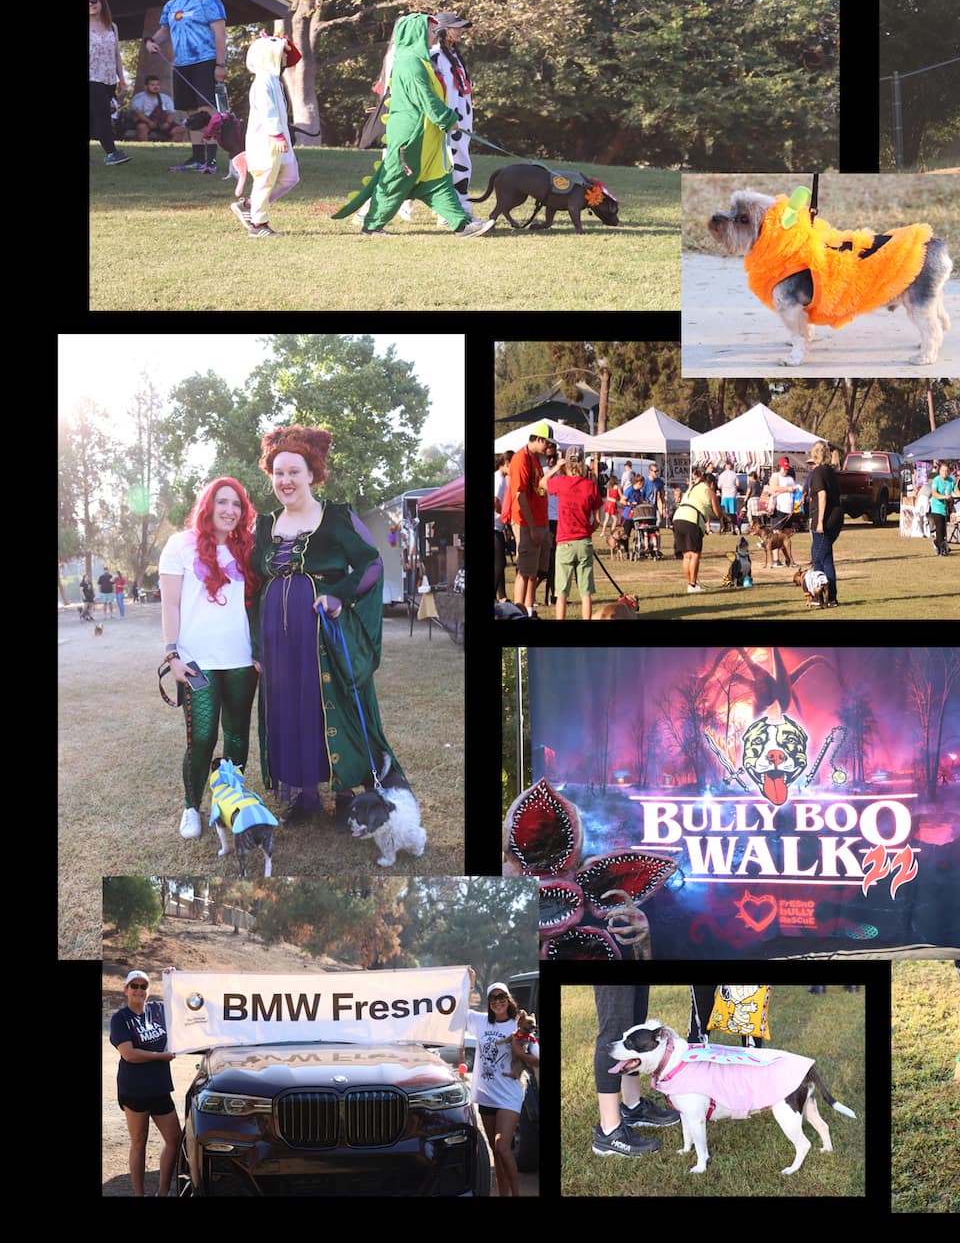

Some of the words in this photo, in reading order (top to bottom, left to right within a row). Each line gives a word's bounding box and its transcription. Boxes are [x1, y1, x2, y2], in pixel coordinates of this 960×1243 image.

[640, 801, 780, 844] BULLY
[794, 799, 912, 847] BOO
[682, 835, 867, 878] WALK
[861, 843, 919, 900] 22
[223, 993, 321, 1022] BMW
[332, 993, 457, 1022] Fresno
[610, 1140, 631, 1153] HOKA
